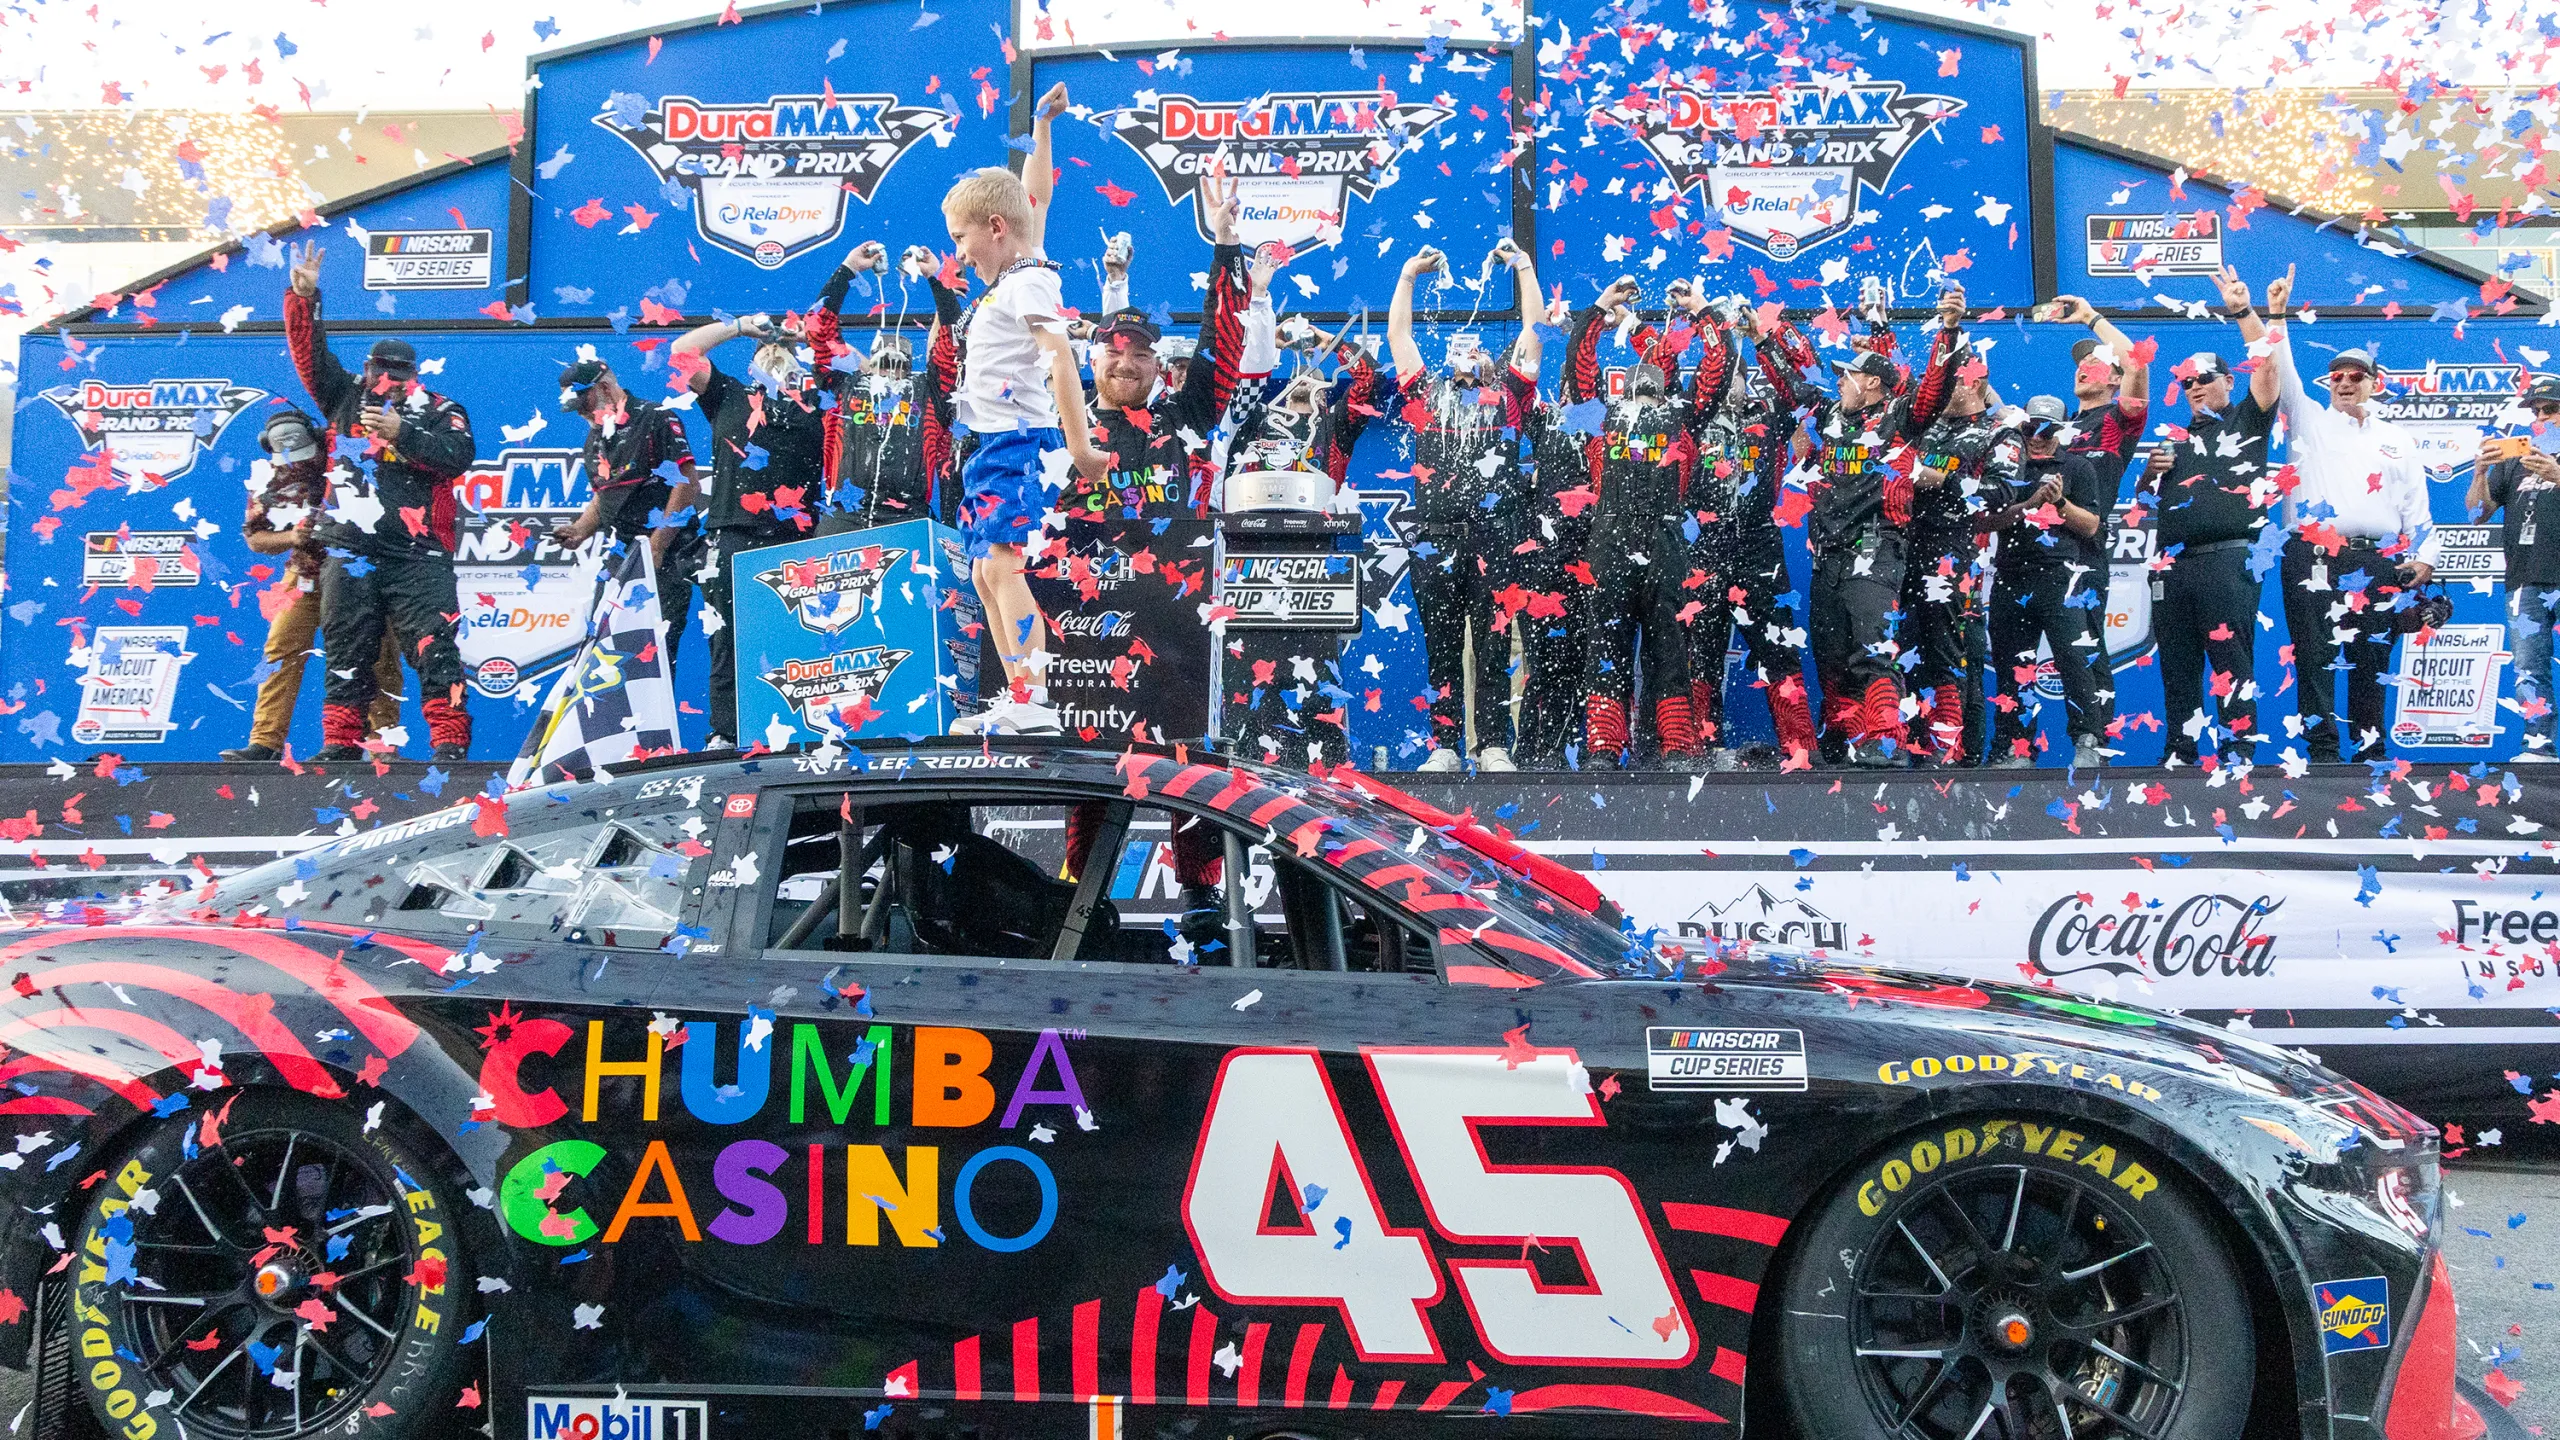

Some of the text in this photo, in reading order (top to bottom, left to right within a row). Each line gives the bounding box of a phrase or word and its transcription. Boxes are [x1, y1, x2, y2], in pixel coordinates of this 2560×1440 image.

[669, 102, 882, 139] DuraMAX
[727, 142, 822, 150] EXAS
[1227, 141, 1322, 149] TEXAS
[1682, 141, 1879, 165] GAND PRIX
[675, 152, 868, 175] GRAND PRIX
[1297, 150, 1368, 173] PRIX
[1752, 197, 1833, 212] RelaDne
[743, 206, 822, 223] RelaDyne
[1243, 205, 1320, 223] RelaDyne
[2129, 220, 2200, 238] NASCR
[405, 235, 474, 253] NASCAR
[2146, 246, 2202, 262] RIES
[387, 260, 473, 276] UP SERIES
[2375, 369, 2515, 394] raMAX
[88, 384, 224, 408] DuraMAX
[850, 397, 922, 414] CHBA
[2377, 403, 2508, 419] GRAND PRIX
[164, 417, 210, 431] PRI
[1610, 446, 1669, 462] CASIN
[1704, 455, 1766, 472] CNO
[1823, 459, 1876, 474] CASINO
[1920, 451, 1974, 476] UMBA
[1075, 464, 1179, 494] CHUMA
[1087, 484, 1180, 512] CASINO
[455, 517, 572, 527] EXAS
[1324, 519, 1350, 530] xfinity
[2436, 530, 2491, 546] ASCAR
[1056, 557, 1136, 581] BSCH
[2437, 554, 2492, 569] SERIES
[789, 574, 871, 598] GRAND PRIX
[817, 573, 851, 583] EXAS
[1224, 591, 1335, 610] CUP RIES
[100, 659, 156, 676] CIRCUIT
[788, 649, 882, 682] DuraMAX
[1048, 653, 1141, 679] Freewy
[2412, 659, 2475, 677] CIRCUIT
[793, 681, 840, 698] GRAND
[845, 675, 877, 692] RIX
[812, 674, 850, 683] TEXA
[1048, 679, 1140, 688] INSURANE
[91, 688, 154, 705] AMERICAS
[2407, 690, 2475, 708] AMERICAS
[832, 755, 1033, 770] TLER REDDICK
[339, 802, 483, 857] Pinnacl
[1075, 904, 1092, 919] 45
[2028, 894, 2287, 978] Coca-Cola
[2461, 960, 2560, 977] INSU
[1697, 1032, 1780, 1049] NASCAR
[476, 1003, 1092, 1131] CHUMBA
[1670, 1057, 1785, 1076] CUP SERIES
[1878, 1051, 2162, 1104] GOODYEAR
[1857, 1119, 2160, 1217] GOODYEAR
[500, 1139, 1059, 1253] CASINO
[1181, 1045, 1699, 1368] 45
[74, 1159, 157, 1440] GOODYEAR
[2322, 1306, 2381, 1330] SUNOCO
[533, 1403, 687, 1440] Mobil 1
